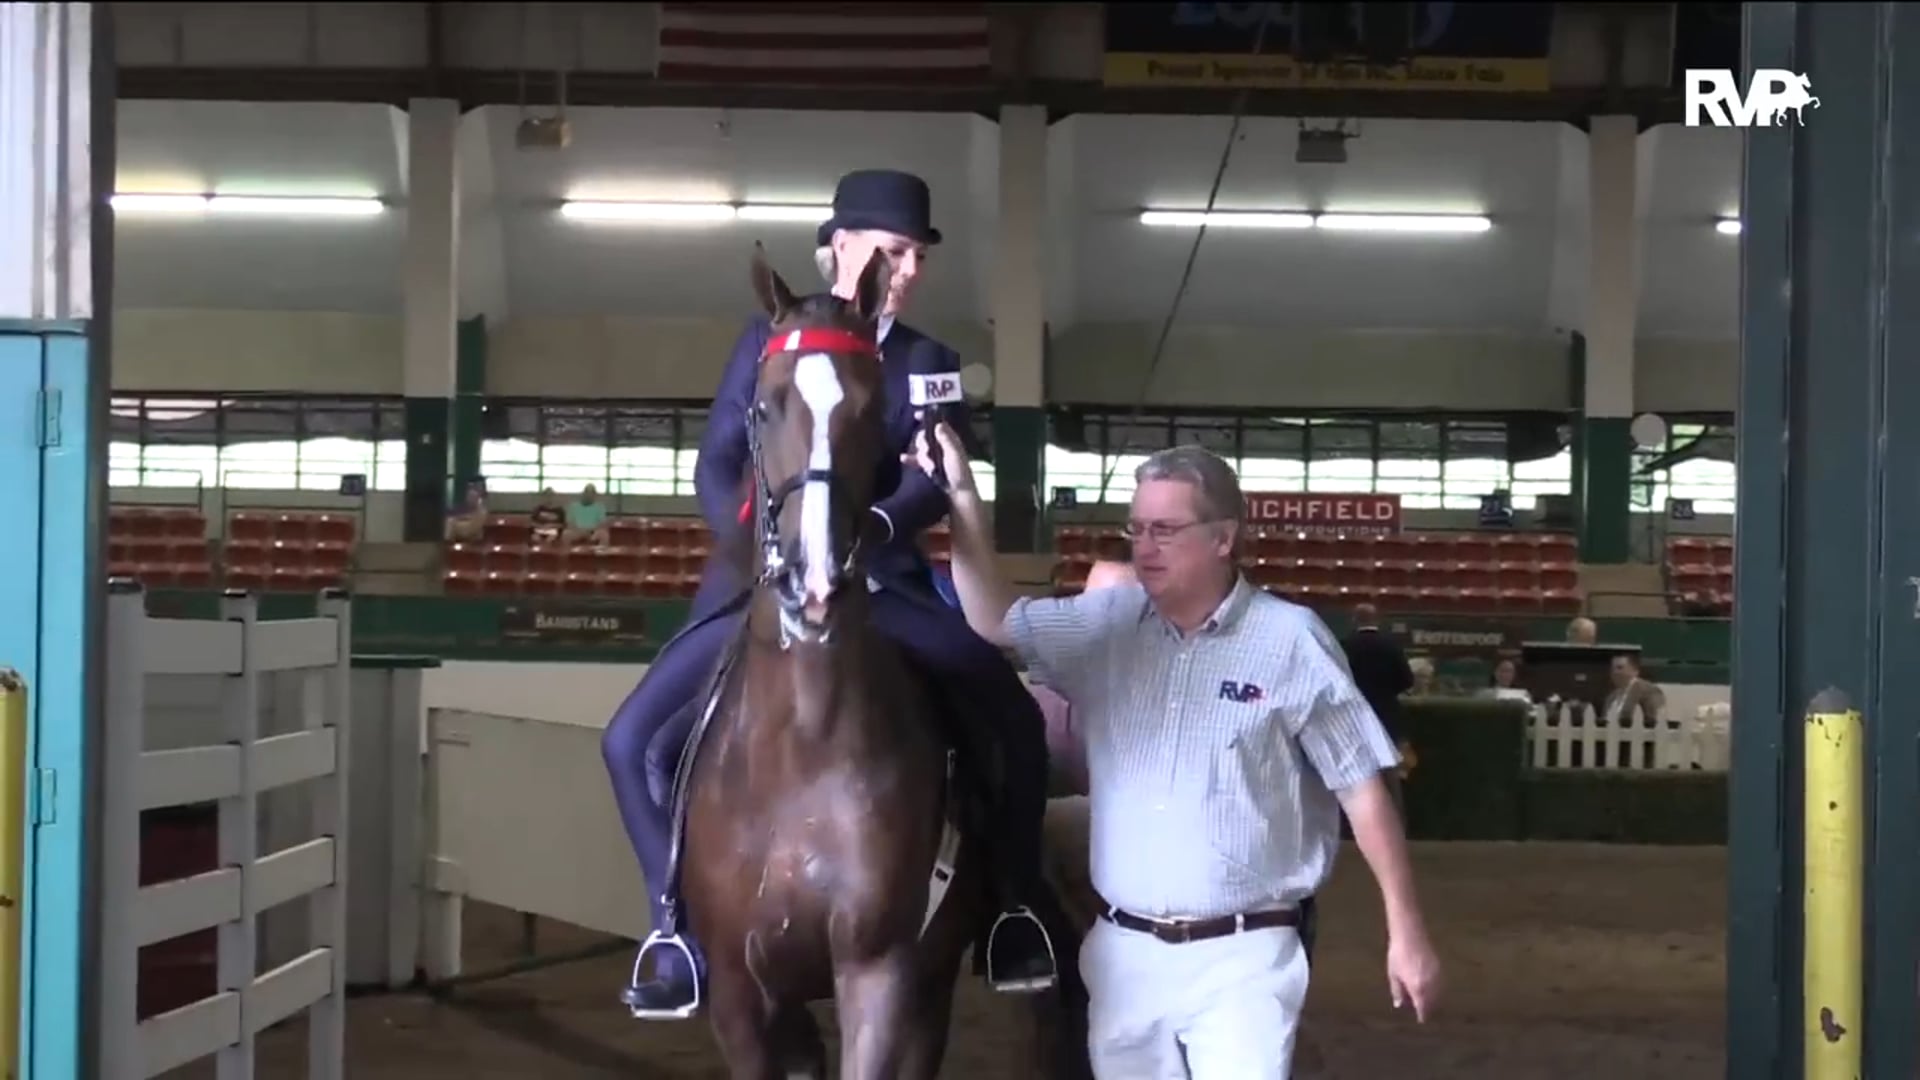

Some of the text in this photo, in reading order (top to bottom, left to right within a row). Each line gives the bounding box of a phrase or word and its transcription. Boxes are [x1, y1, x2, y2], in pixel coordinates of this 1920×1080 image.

[925, 380, 954, 399] RVP
[1245, 500, 1394, 520] ICHFIELD
[1219, 681, 1261, 702] RVP
